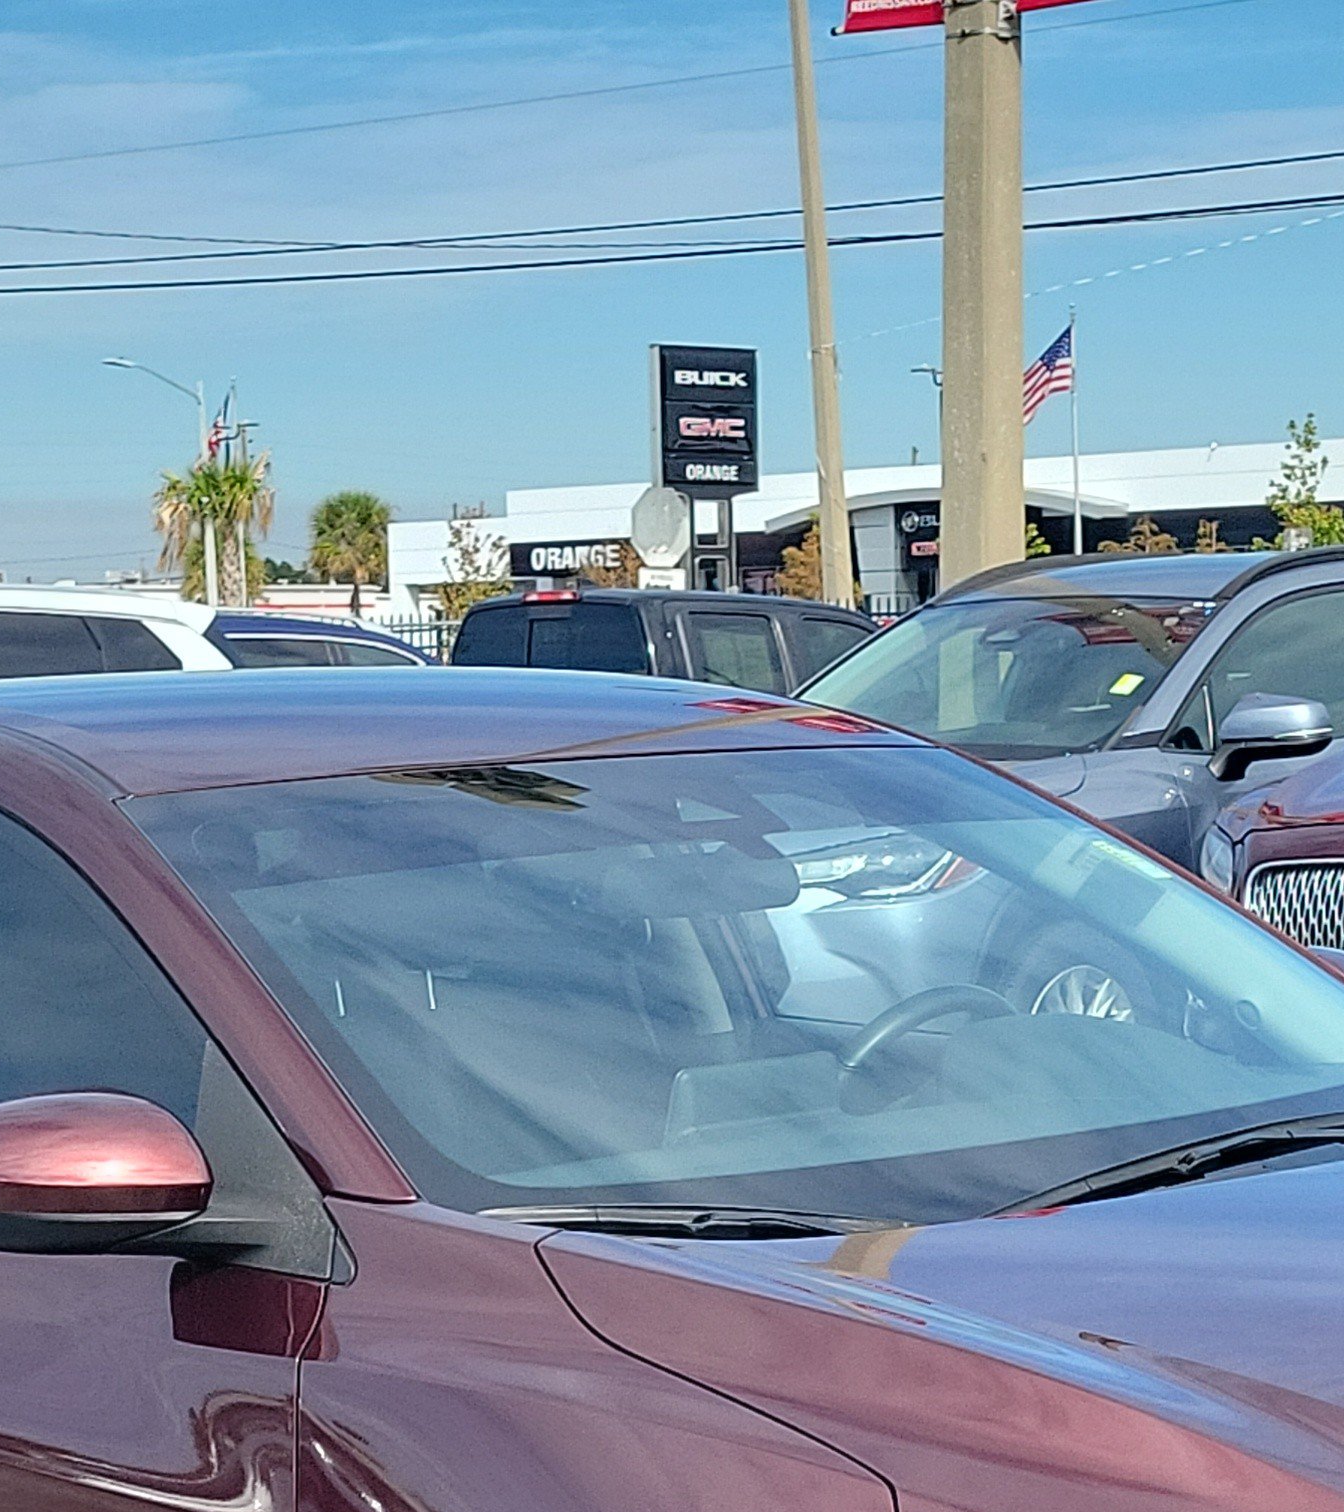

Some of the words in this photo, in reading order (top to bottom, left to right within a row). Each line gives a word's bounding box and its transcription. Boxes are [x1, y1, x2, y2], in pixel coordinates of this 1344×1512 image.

[674, 370, 749, 387] BUICK
[679, 416, 746, 438] GMC
[685, 463, 739, 481] ORANGE
[530, 544, 622, 571] ORANGE
